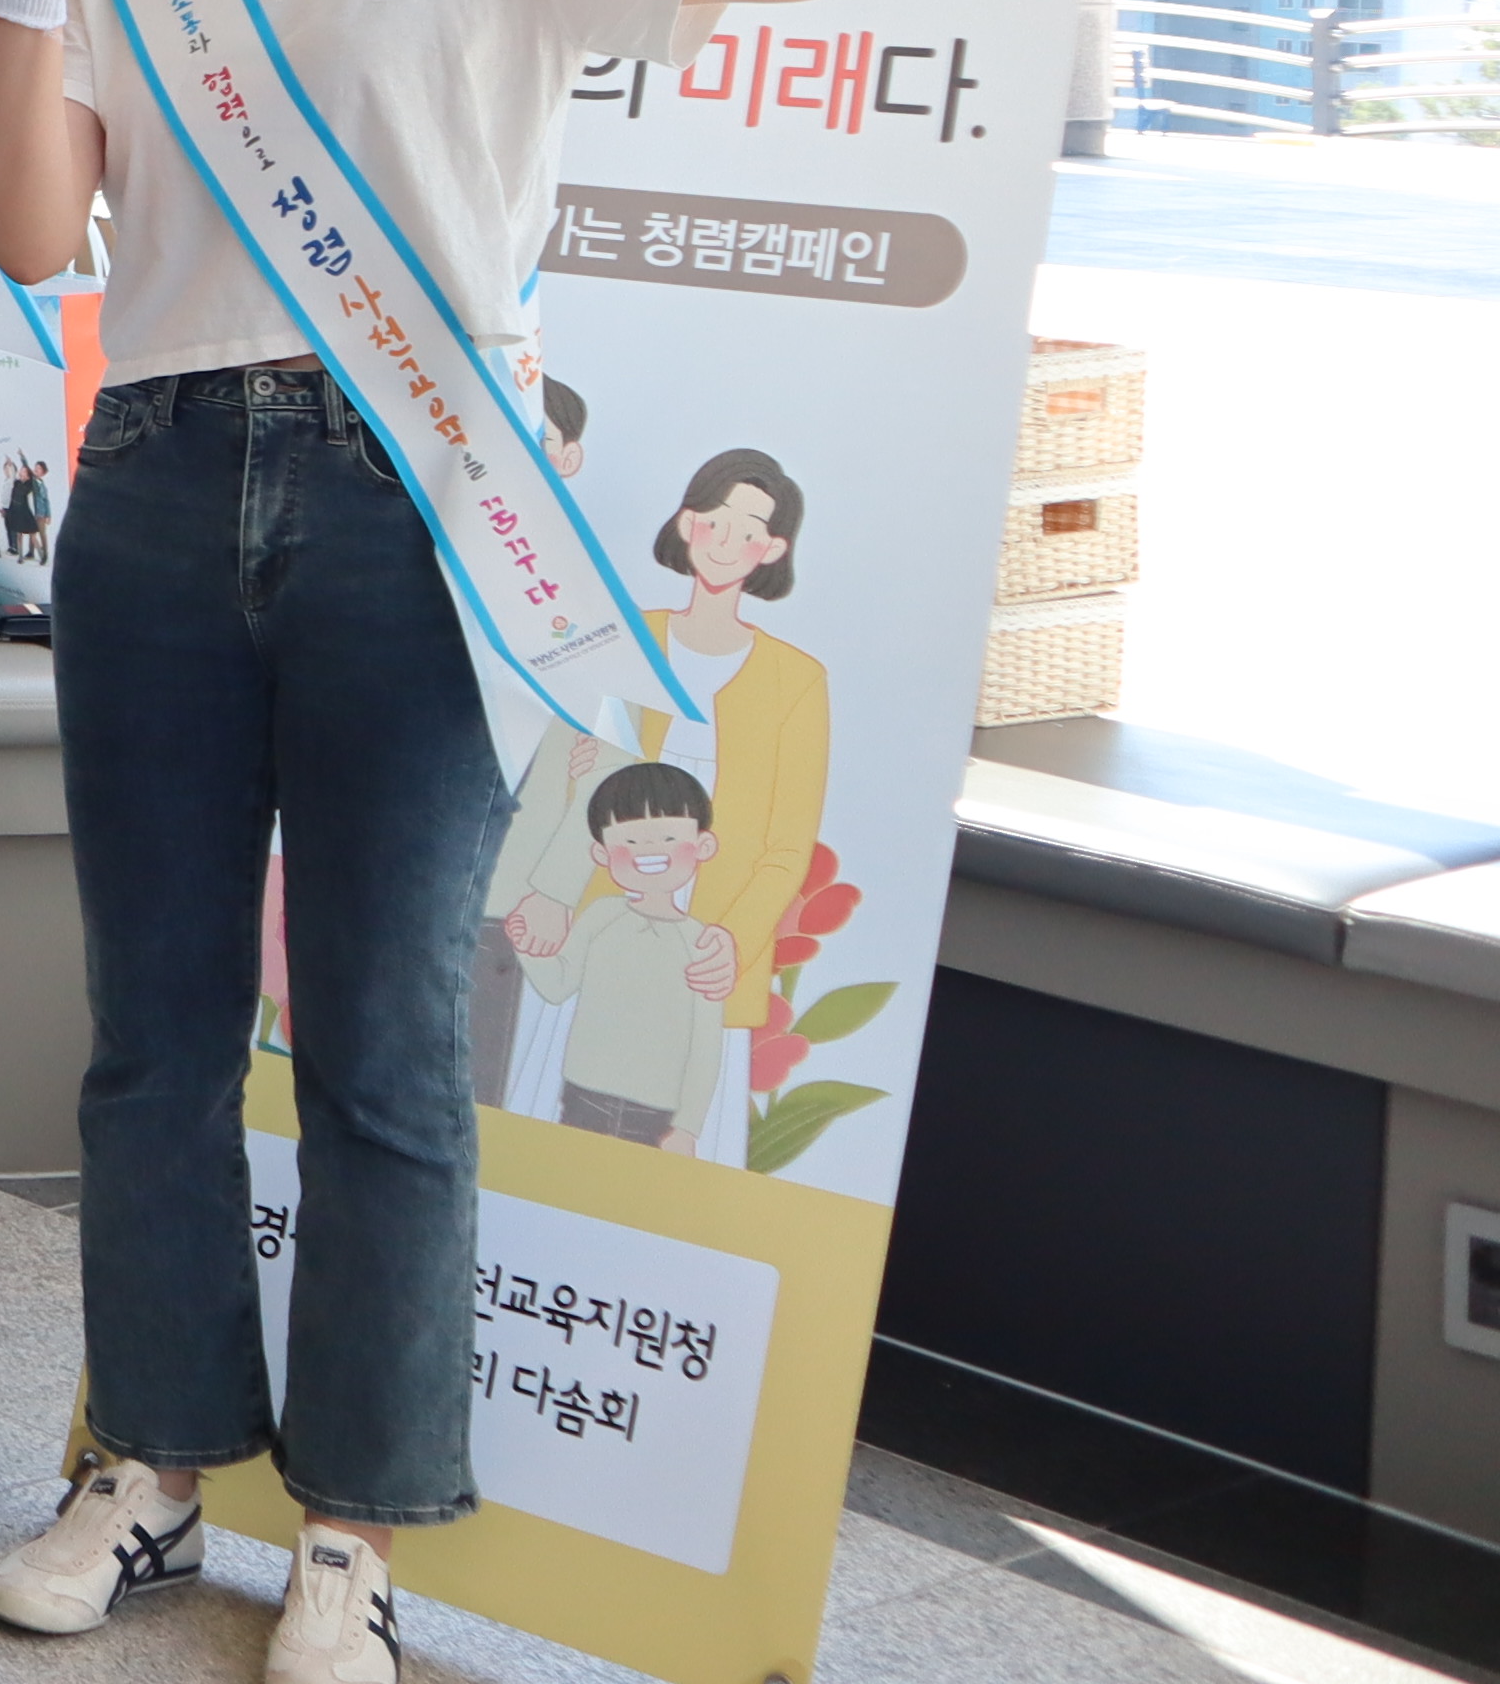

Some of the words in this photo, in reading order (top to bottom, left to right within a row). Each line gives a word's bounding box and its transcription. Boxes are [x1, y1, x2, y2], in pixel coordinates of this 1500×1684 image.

[677, 25, 988, 143] 미래다.
[641, 208, 891, 288] 청렴캠페인
[202, 66, 276, 172] 협력으로
[271, 175, 353, 277] 청렴
[339, 273, 488, 482] 사천교육을
[479, 496, 560, 607] 꿈꾸다
[511, 1364, 640, 1443] 다솜회
